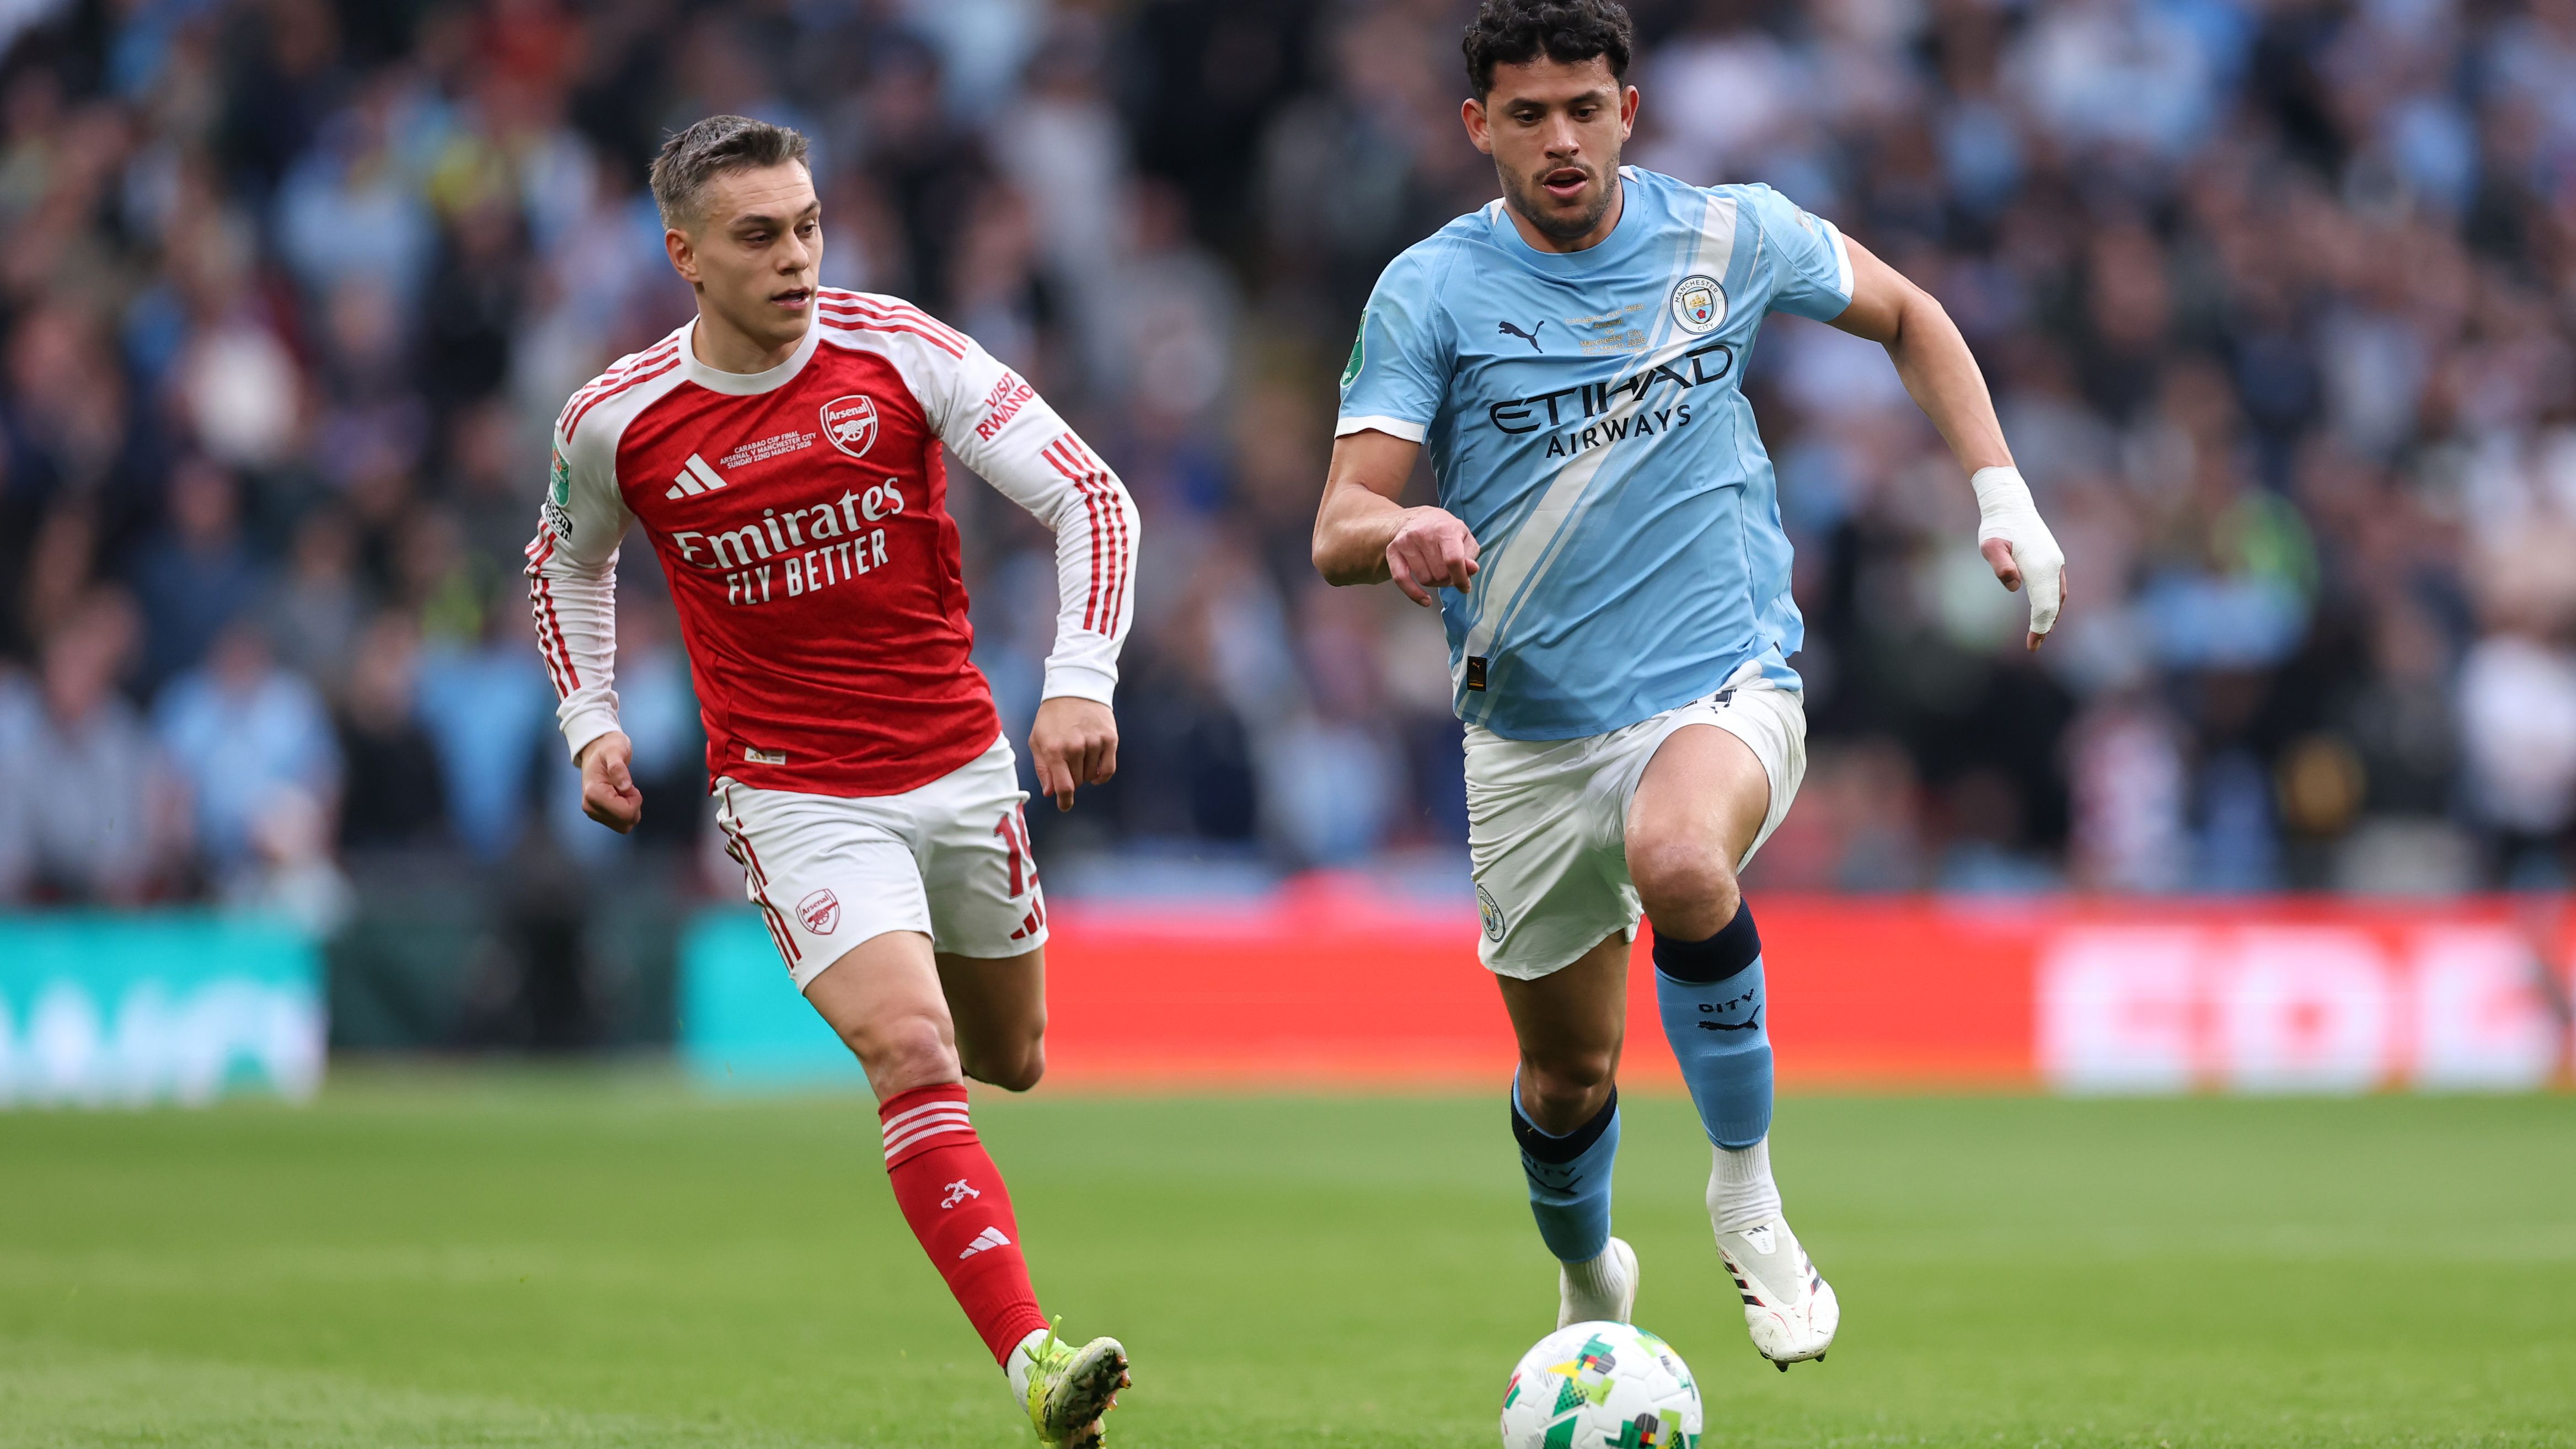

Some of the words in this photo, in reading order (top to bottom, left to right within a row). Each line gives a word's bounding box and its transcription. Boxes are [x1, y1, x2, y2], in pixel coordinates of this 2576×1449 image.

[1675, 280, 1718, 303] MANCHESTER
[1593, 318, 1623, 329] Arsenal
[1606, 309, 1622, 319] CUP
[1579, 334, 1623, 347] Manchester
[1627, 329, 1642, 338] City
[1697, 323, 1713, 331] CITY
[984, 372, 1015, 408] VISIT
[1490, 344, 1733, 435] ETIHAD
[829, 403, 867, 421] Arsenal
[735, 440, 766, 453] CARABAO
[781, 430, 800, 441] FINAL
[1546, 404, 1691, 458] AIRWAYS
[720, 452, 750, 465] ARSENAL
[757, 437, 800, 453] MANCHESTER
[802, 432, 817, 441] CITY
[727, 457, 752, 469] SUNDAY
[753, 452, 770, 462] 22ND
[772, 444, 796, 457] MARCH
[797, 440, 812, 450] 2026
[672, 477, 904, 569] Emirates
[726, 565, 771, 606] FLY
[785, 528, 890, 597] BETTER
[802, 895, 829, 916] Arsenal
